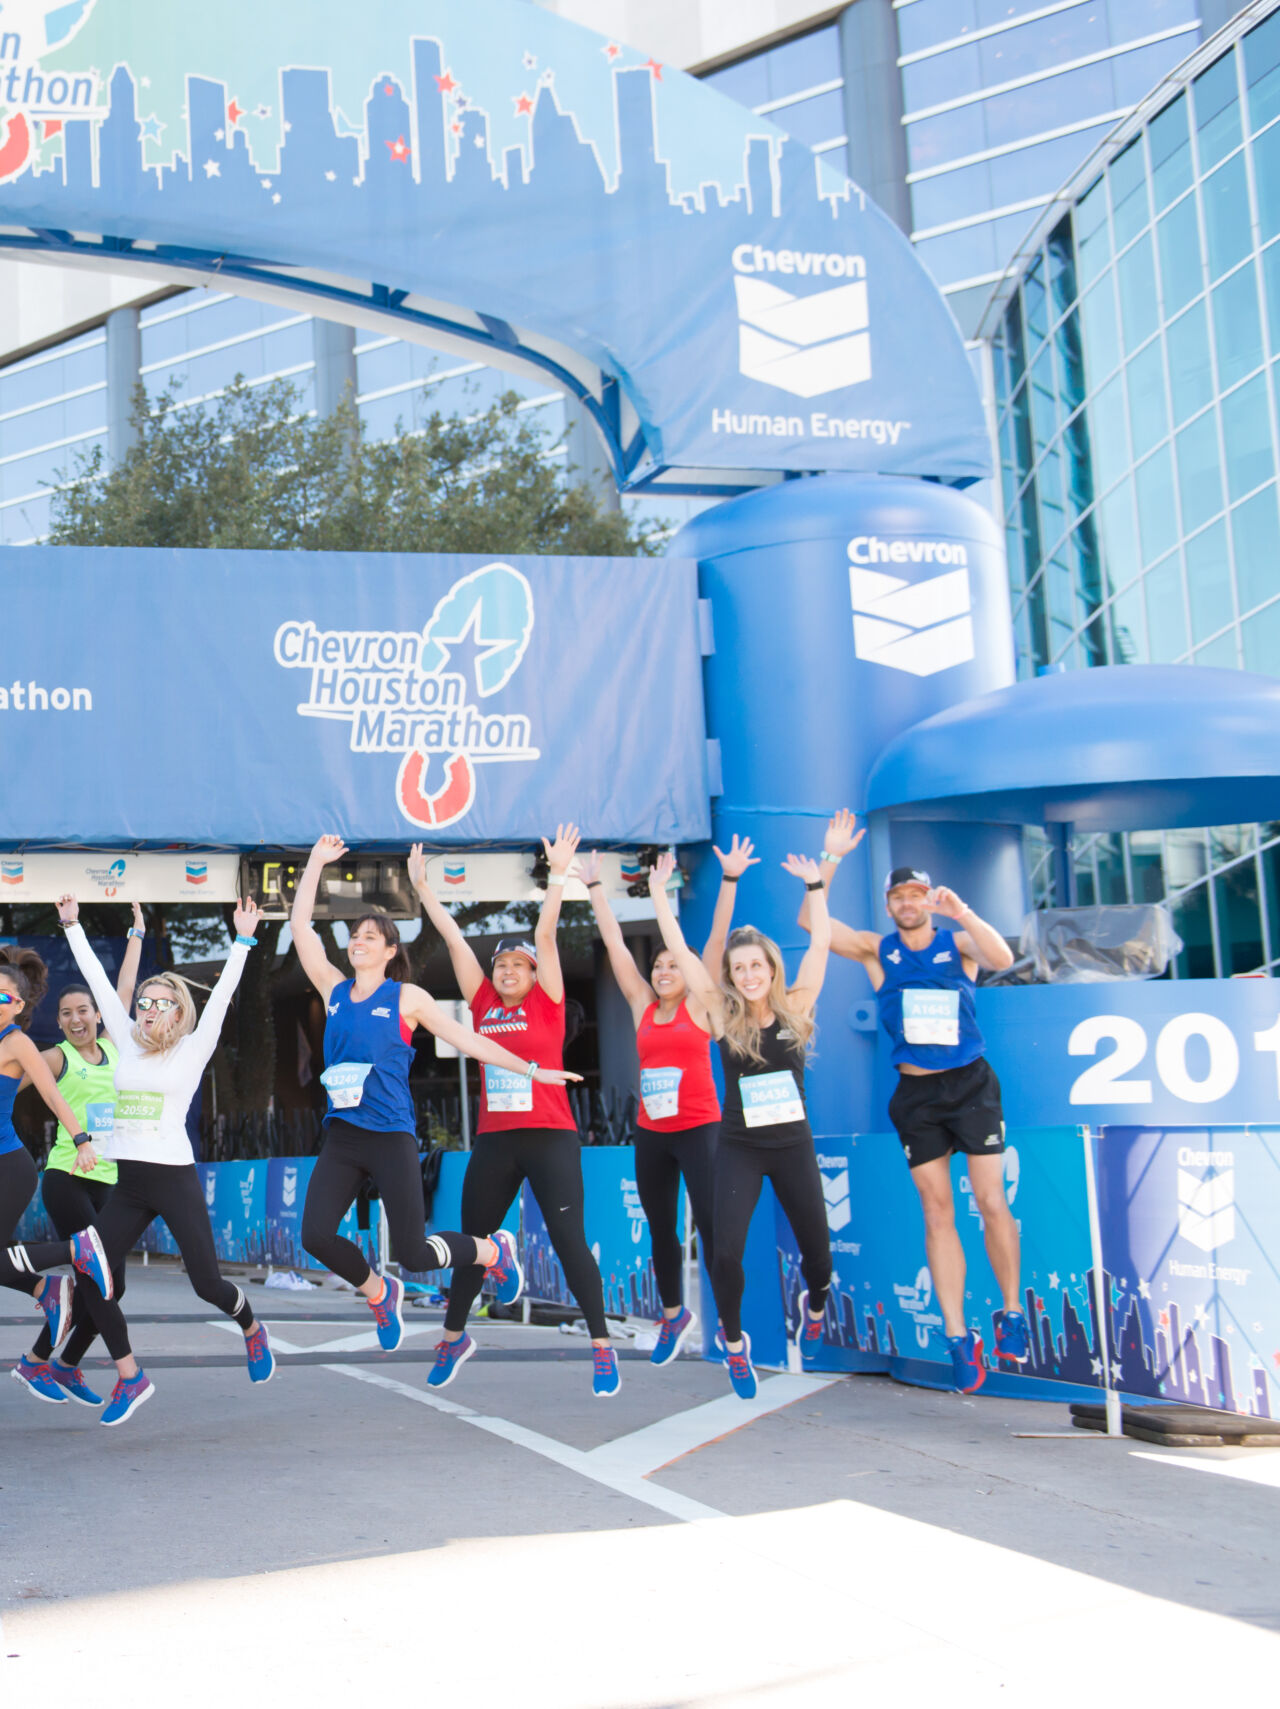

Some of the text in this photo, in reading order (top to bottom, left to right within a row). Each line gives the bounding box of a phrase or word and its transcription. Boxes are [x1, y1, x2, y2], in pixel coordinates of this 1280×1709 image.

[732, 244, 866, 278] Chevron
[712, 407, 805, 437] Human
[847, 536, 968, 567] Chevron
[278, 626, 419, 665] Chevron
[320, 669, 462, 707] Houston
[355, 709, 527, 748] Marathon
[1178, 1146, 1235, 1168] Chevron
